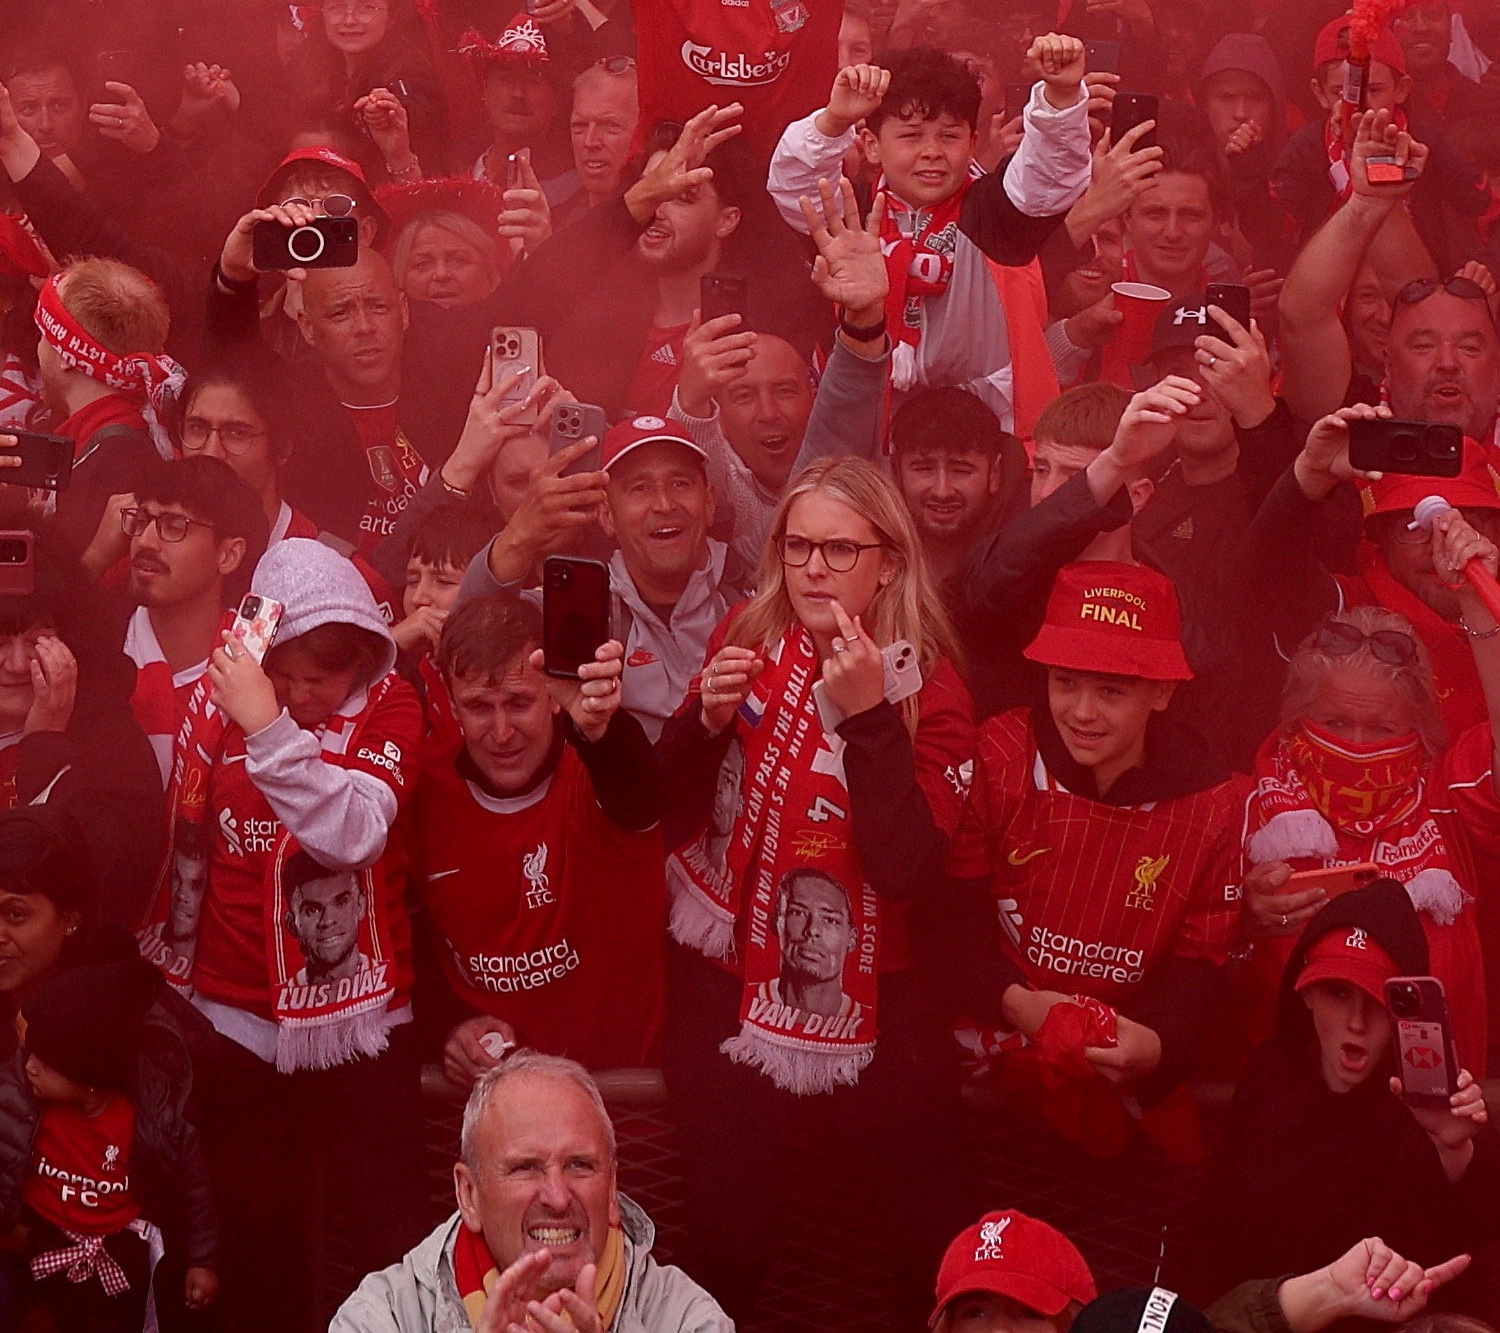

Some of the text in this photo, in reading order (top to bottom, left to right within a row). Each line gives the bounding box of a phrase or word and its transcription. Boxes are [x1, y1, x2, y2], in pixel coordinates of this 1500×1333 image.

[681, 39, 792, 85] Carlsberg
[1081, 603, 1143, 631] FINAL
[1084, 587, 1147, 611] LIVERPOOL
[773, 705, 794, 742] THE
[755, 742, 782, 786] PASS
[747, 788, 766, 823] CAN
[806, 795, 846, 823] 4
[761, 809, 783, 866] VIRGIL
[1382, 822, 1440, 863] Foundatio
[527, 893, 557, 910] L.F.C.
[754, 868, 773, 905] VAN
[750, 908, 767, 950] DIJK
[1030, 925, 1144, 968] standard
[468, 937, 569, 974] standard
[859, 922, 877, 974] SCORE
[1027, 945, 1145, 984] chartered
[277, 984, 332, 1010] LUIS
[748, 996, 801, 1031] VAN
[62, 1184, 99, 1208] FC
